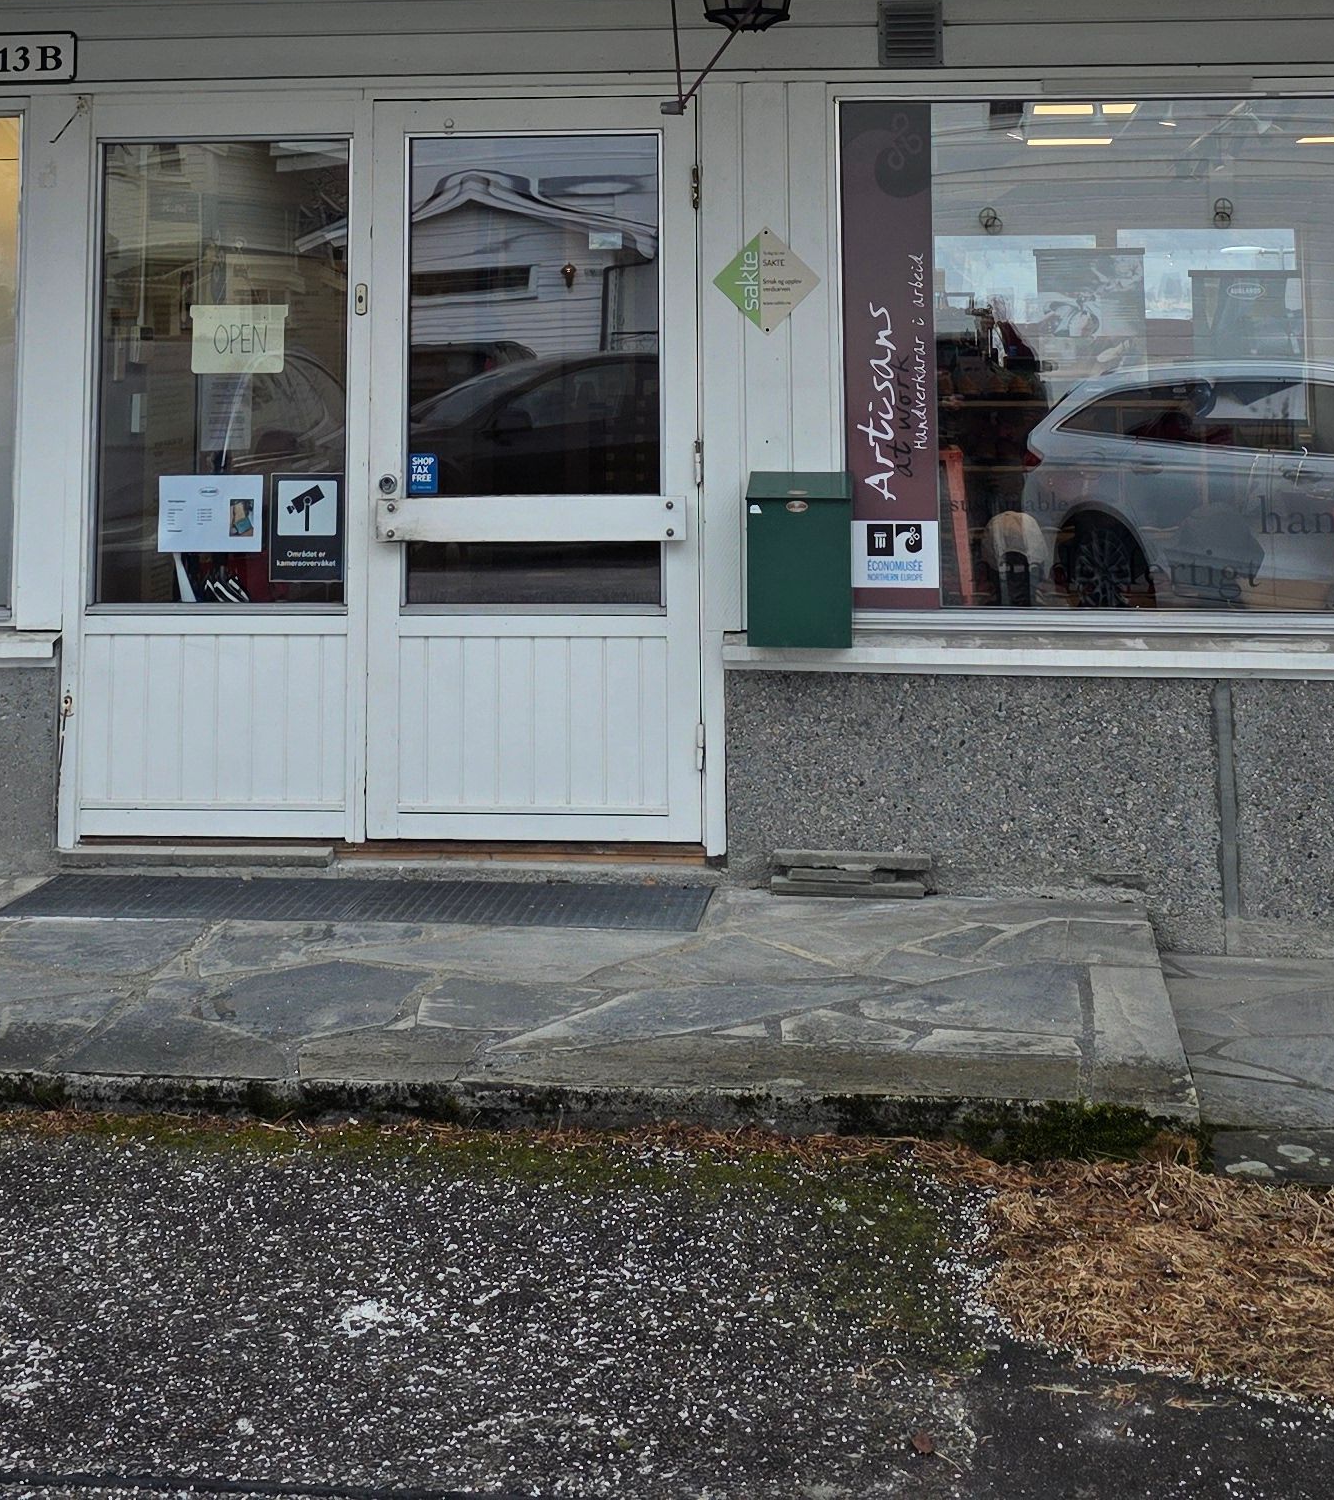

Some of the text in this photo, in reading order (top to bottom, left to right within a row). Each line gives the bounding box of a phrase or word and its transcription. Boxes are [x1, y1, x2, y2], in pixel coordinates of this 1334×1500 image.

[734, 251, 759, 311] sakte
[908, 252, 925, 308] arbeid
[213, 323, 267, 355] OPEN
[857, 301, 896, 501] Artisans
[885, 353, 914, 479] at work
[412, 456, 435, 465] SHOP
[412, 465, 429, 474] TAX
[411, 473, 432, 482] FREE
[867, 559, 923, 572] ÉCONOMUSÉE
[867, 573, 923, 582] NORTHERN EUROPE
